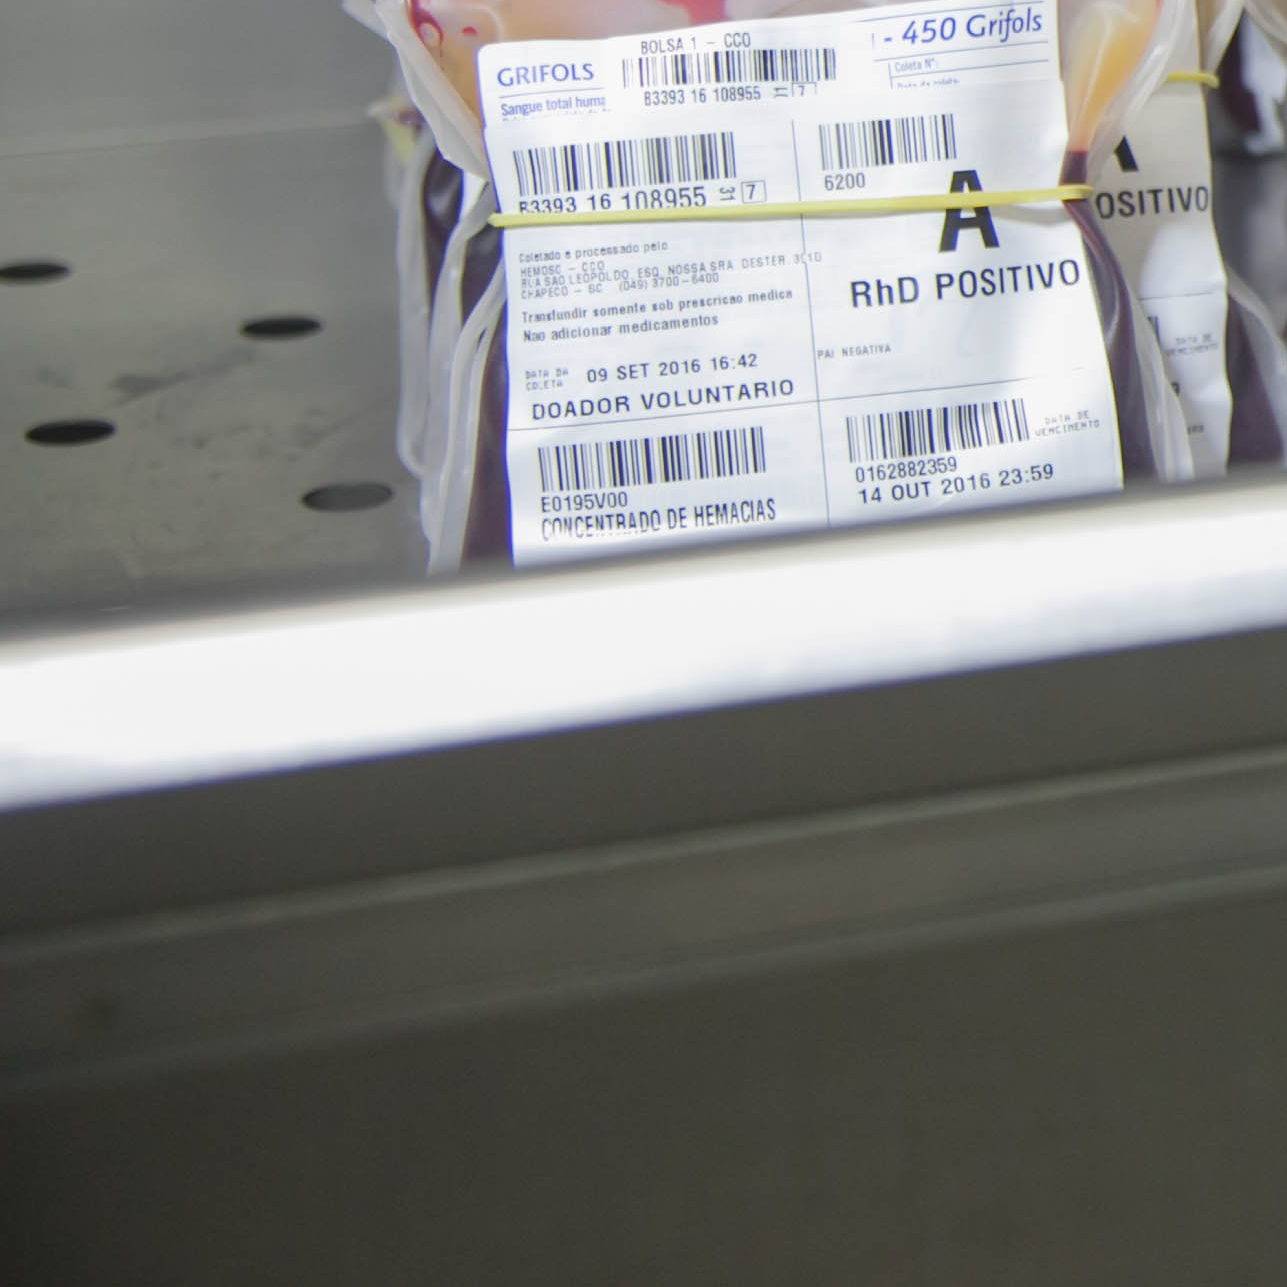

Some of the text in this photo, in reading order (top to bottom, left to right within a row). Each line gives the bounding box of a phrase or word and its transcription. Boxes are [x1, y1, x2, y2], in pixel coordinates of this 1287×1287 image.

[902, 6, 1043, 45] 450 Grifols
[640, 32, 752, 55] BOLSA 1 CCO
[497, 62, 596, 88] GRIFOLS
[501, 96, 544, 118] Sangue
[547, 91, 573, 110] total
[643, 87, 687, 106] B3393
[691, 85, 708, 103] 16
[714, 81, 763, 101] 108955
[824, 172, 867, 191] 6200
[587, 192, 613, 212] 16
[621, 186, 708, 211] 108955
[938, 170, 1001, 253] A
[1095, 185, 1210, 220] OSITIVO
[575, 244, 640, 261] processado
[851, 258, 1082, 308] RhD POSITIVO
[593, 301, 647, 318] somente
[651, 298, 675, 314] sob
[748, 288, 794, 304] medica
[523, 313, 720, 344] Nao adicionar medicamentos
[587, 352, 759, 384] 09 SET 2016 16:42
[532, 378, 795, 422] DOADOR VOLUNTARIO
[855, 456, 958, 484] 0162882359
[858, 462, 1055, 505] 14 OUT 2016 23:59
[541, 491, 630, 514] E0195V00
[667, 506, 690, 531] DE
[695, 497, 777, 528] HEMACIAS
